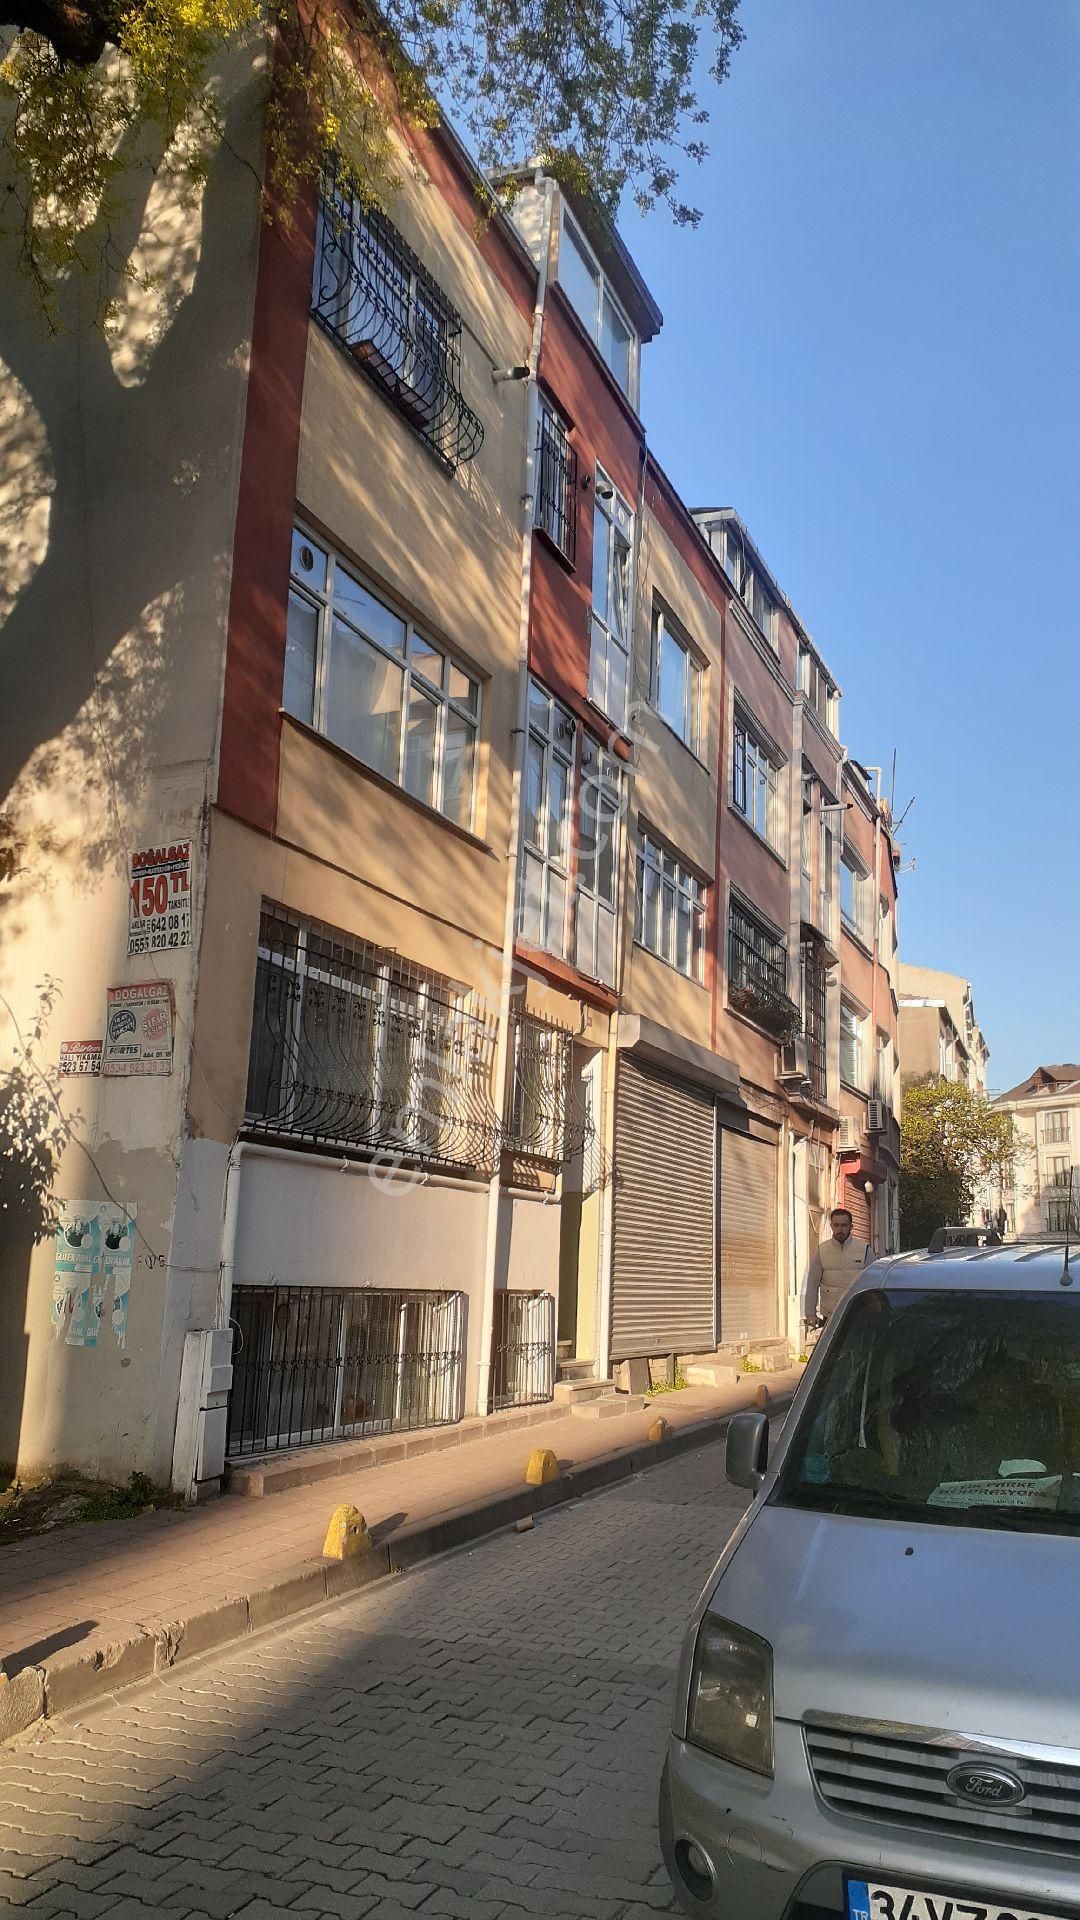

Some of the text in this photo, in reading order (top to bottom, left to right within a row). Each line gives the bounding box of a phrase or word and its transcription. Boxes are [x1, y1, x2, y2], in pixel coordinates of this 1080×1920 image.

[131, 871, 190, 918] 150 TL
[151, 917, 166, 933] 642
[168, 915, 179, 930] 08
[151, 933, 166, 948] 820
[168, 932, 179, 948] 42
[76, 1053, 101, 1061] YIKAMA
[62, 1061, 76, 1072] 523
[91, 1060, 101, 1071] 54
[965, 1776, 1003, 1797] Ford
